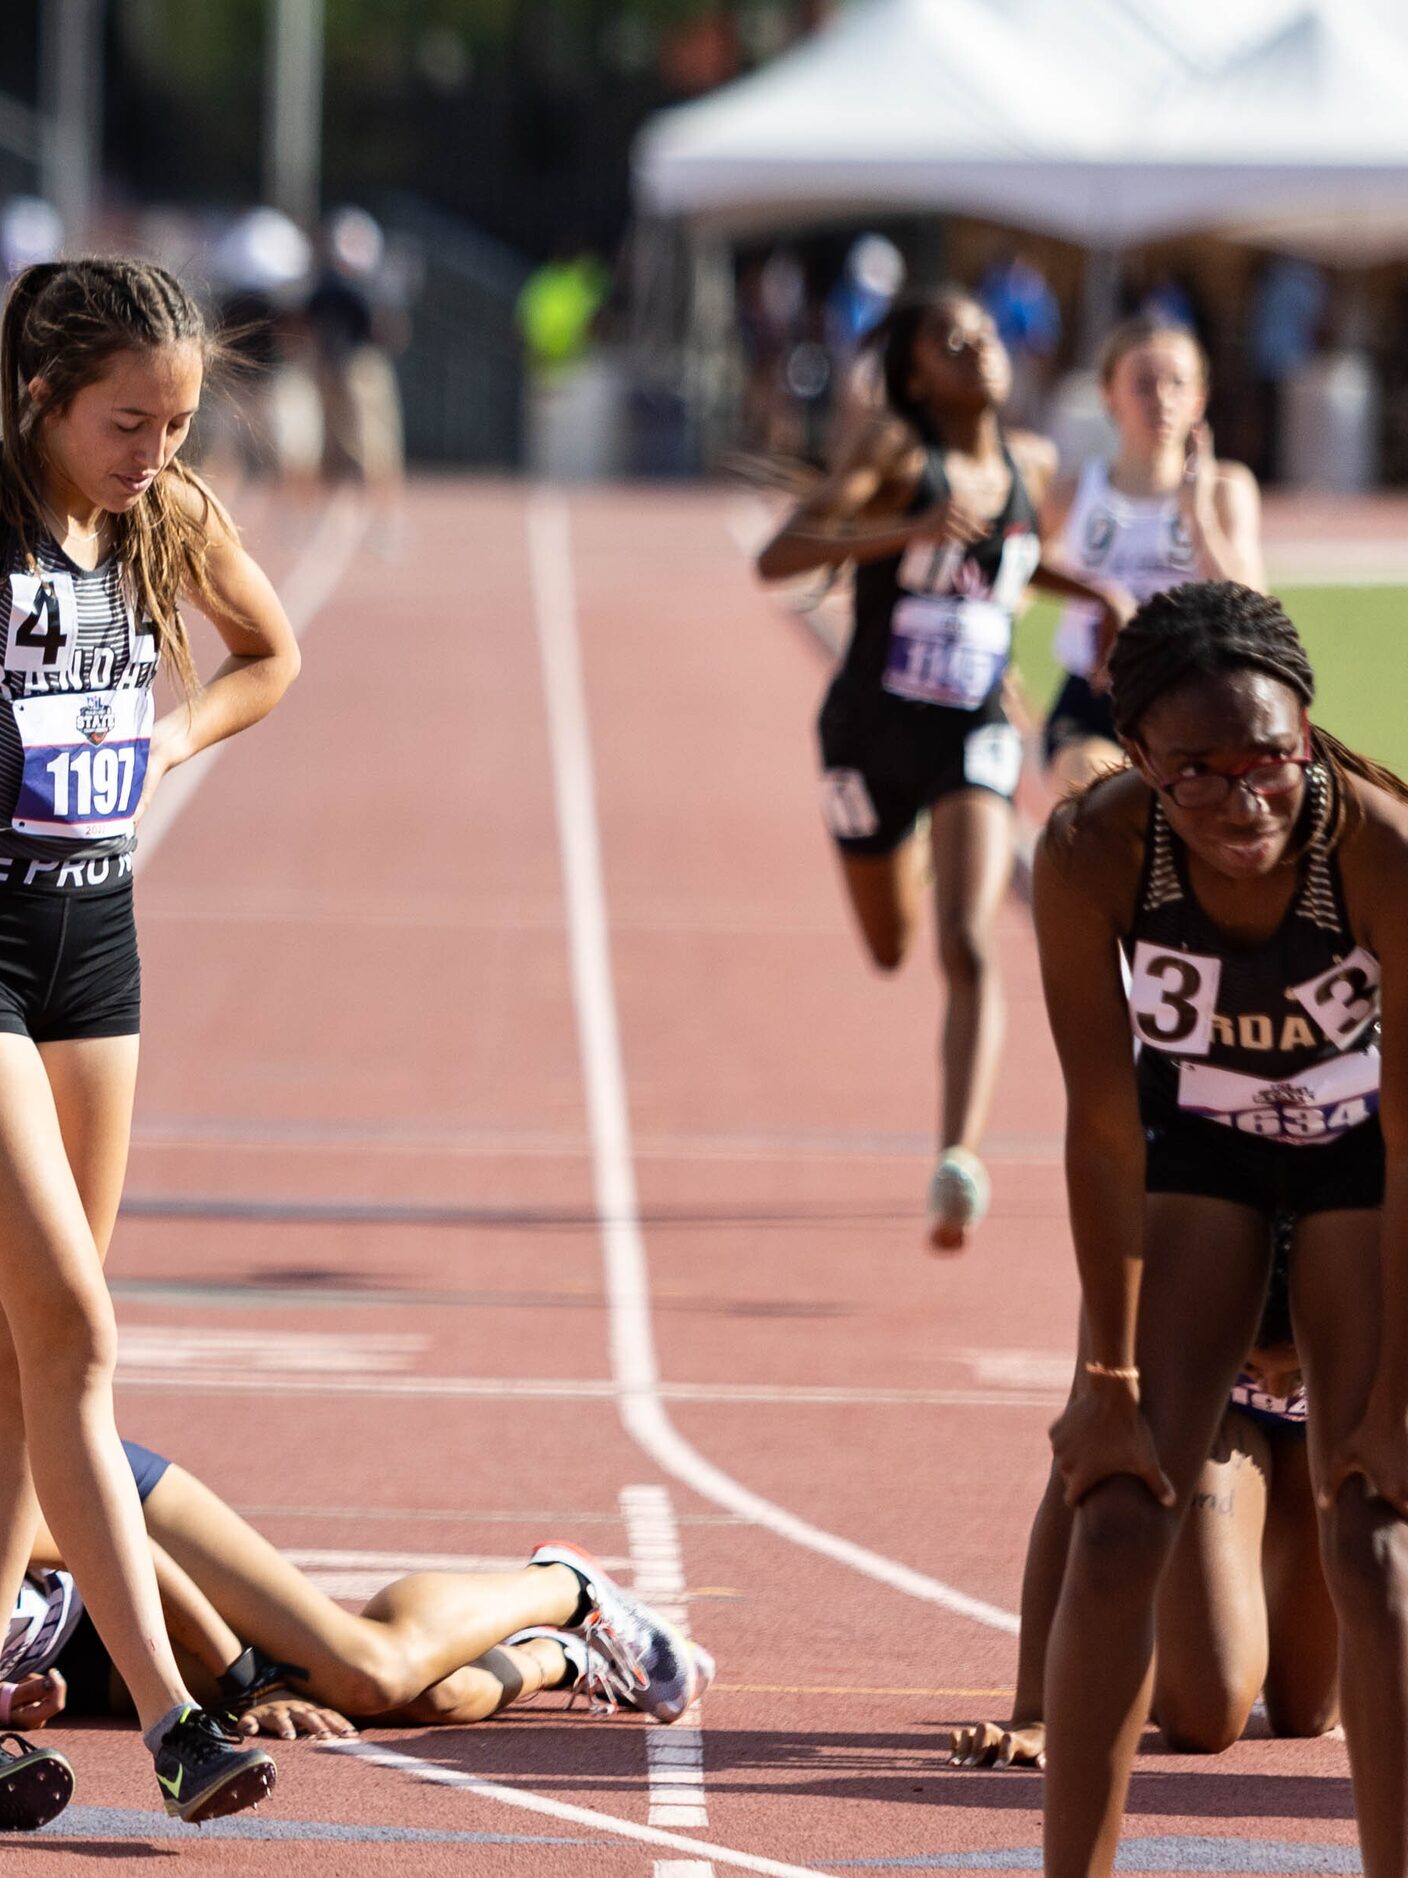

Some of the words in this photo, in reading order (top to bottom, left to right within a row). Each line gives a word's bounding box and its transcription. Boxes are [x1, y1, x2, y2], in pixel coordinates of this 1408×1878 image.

[14, 580, 67, 666] 4
[46, 748, 136, 817] 1197
[23, 855, 110, 888] PRO
[1137, 955, 1202, 1043] 3
[1211, 1014, 1316, 1051] RDA
[1314, 966, 1377, 1034] 3
